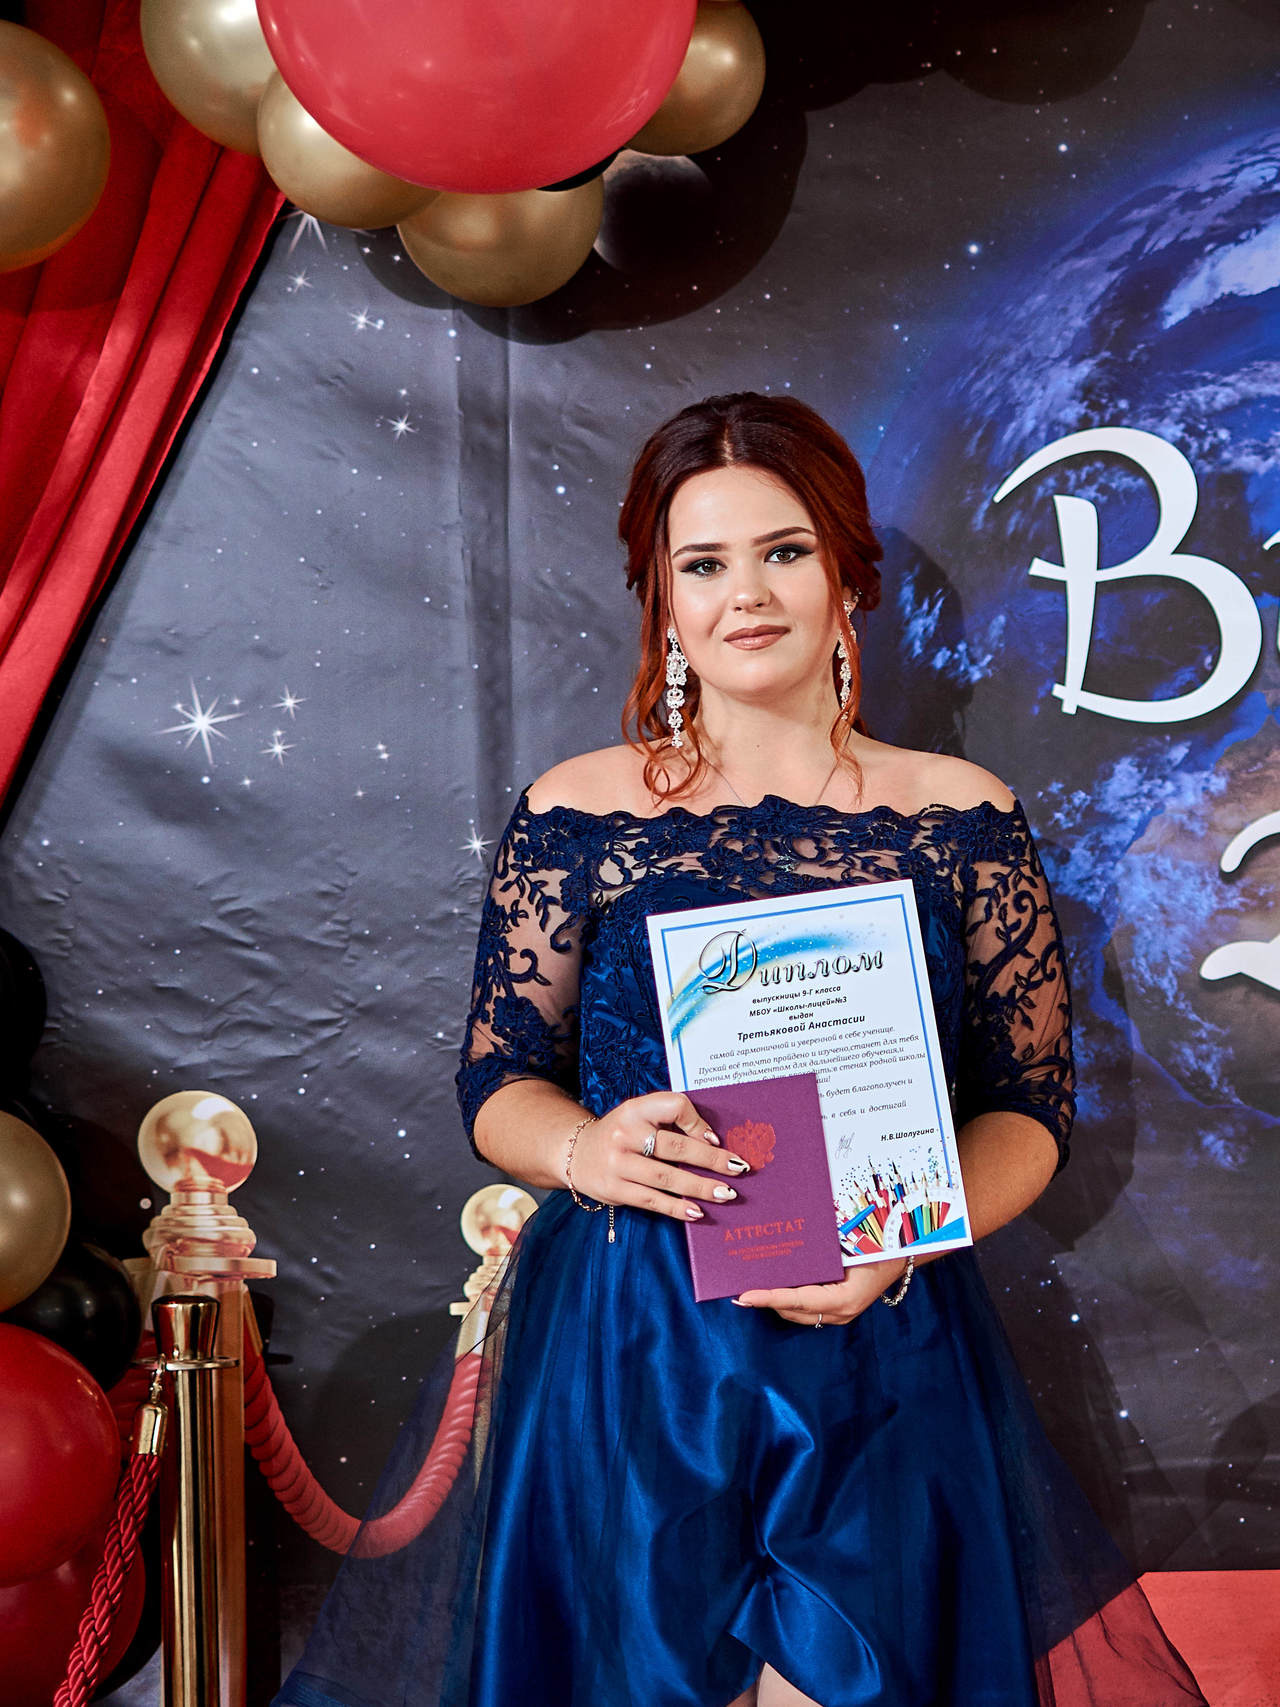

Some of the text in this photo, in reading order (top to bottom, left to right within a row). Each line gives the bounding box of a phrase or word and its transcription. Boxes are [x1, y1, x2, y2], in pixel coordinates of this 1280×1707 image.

[698, 928, 884, 995] Диплом
[752, 991, 801, 1004] выпускницы
[814, 985, 841, 995] класса
[749, 1007, 772, 1018] МБОУ
[788, 1011, 814, 1021] выдан
[737, 1015, 866, 1043] Третьяковой Анастасии
[698, 1062, 727, 1076] Пускай
[773, 1051, 810, 1065] пройдено
[882, 1037, 897, 1047] для
[899, 1034, 920, 1044] тебя
[709, 1050, 735, 1061] самой
[736, 1040, 789, 1057] гармоничной
[797, 1034, 837, 1049] уверенной
[844, 1029, 861, 1040] себе
[694, 1073, 731, 1086] прочным
[732, 1063, 791, 1081] фундаментом
[792, 1061, 807, 1070] для
[808, 1053, 860, 1067] дальнейшего
[839, 1060, 867, 1073] стенах
[869, 1056, 897, 1069] родной
[898, 1052, 926, 1063] школы
[826, 1086, 851, 1100] будет
[851, 1079, 906, 1095] благополучен
[839, 1108, 857, 1118] себя
[868, 1100, 907, 1113] достигай
[724, 1217, 806, 1242] АТТЕСТАТ
